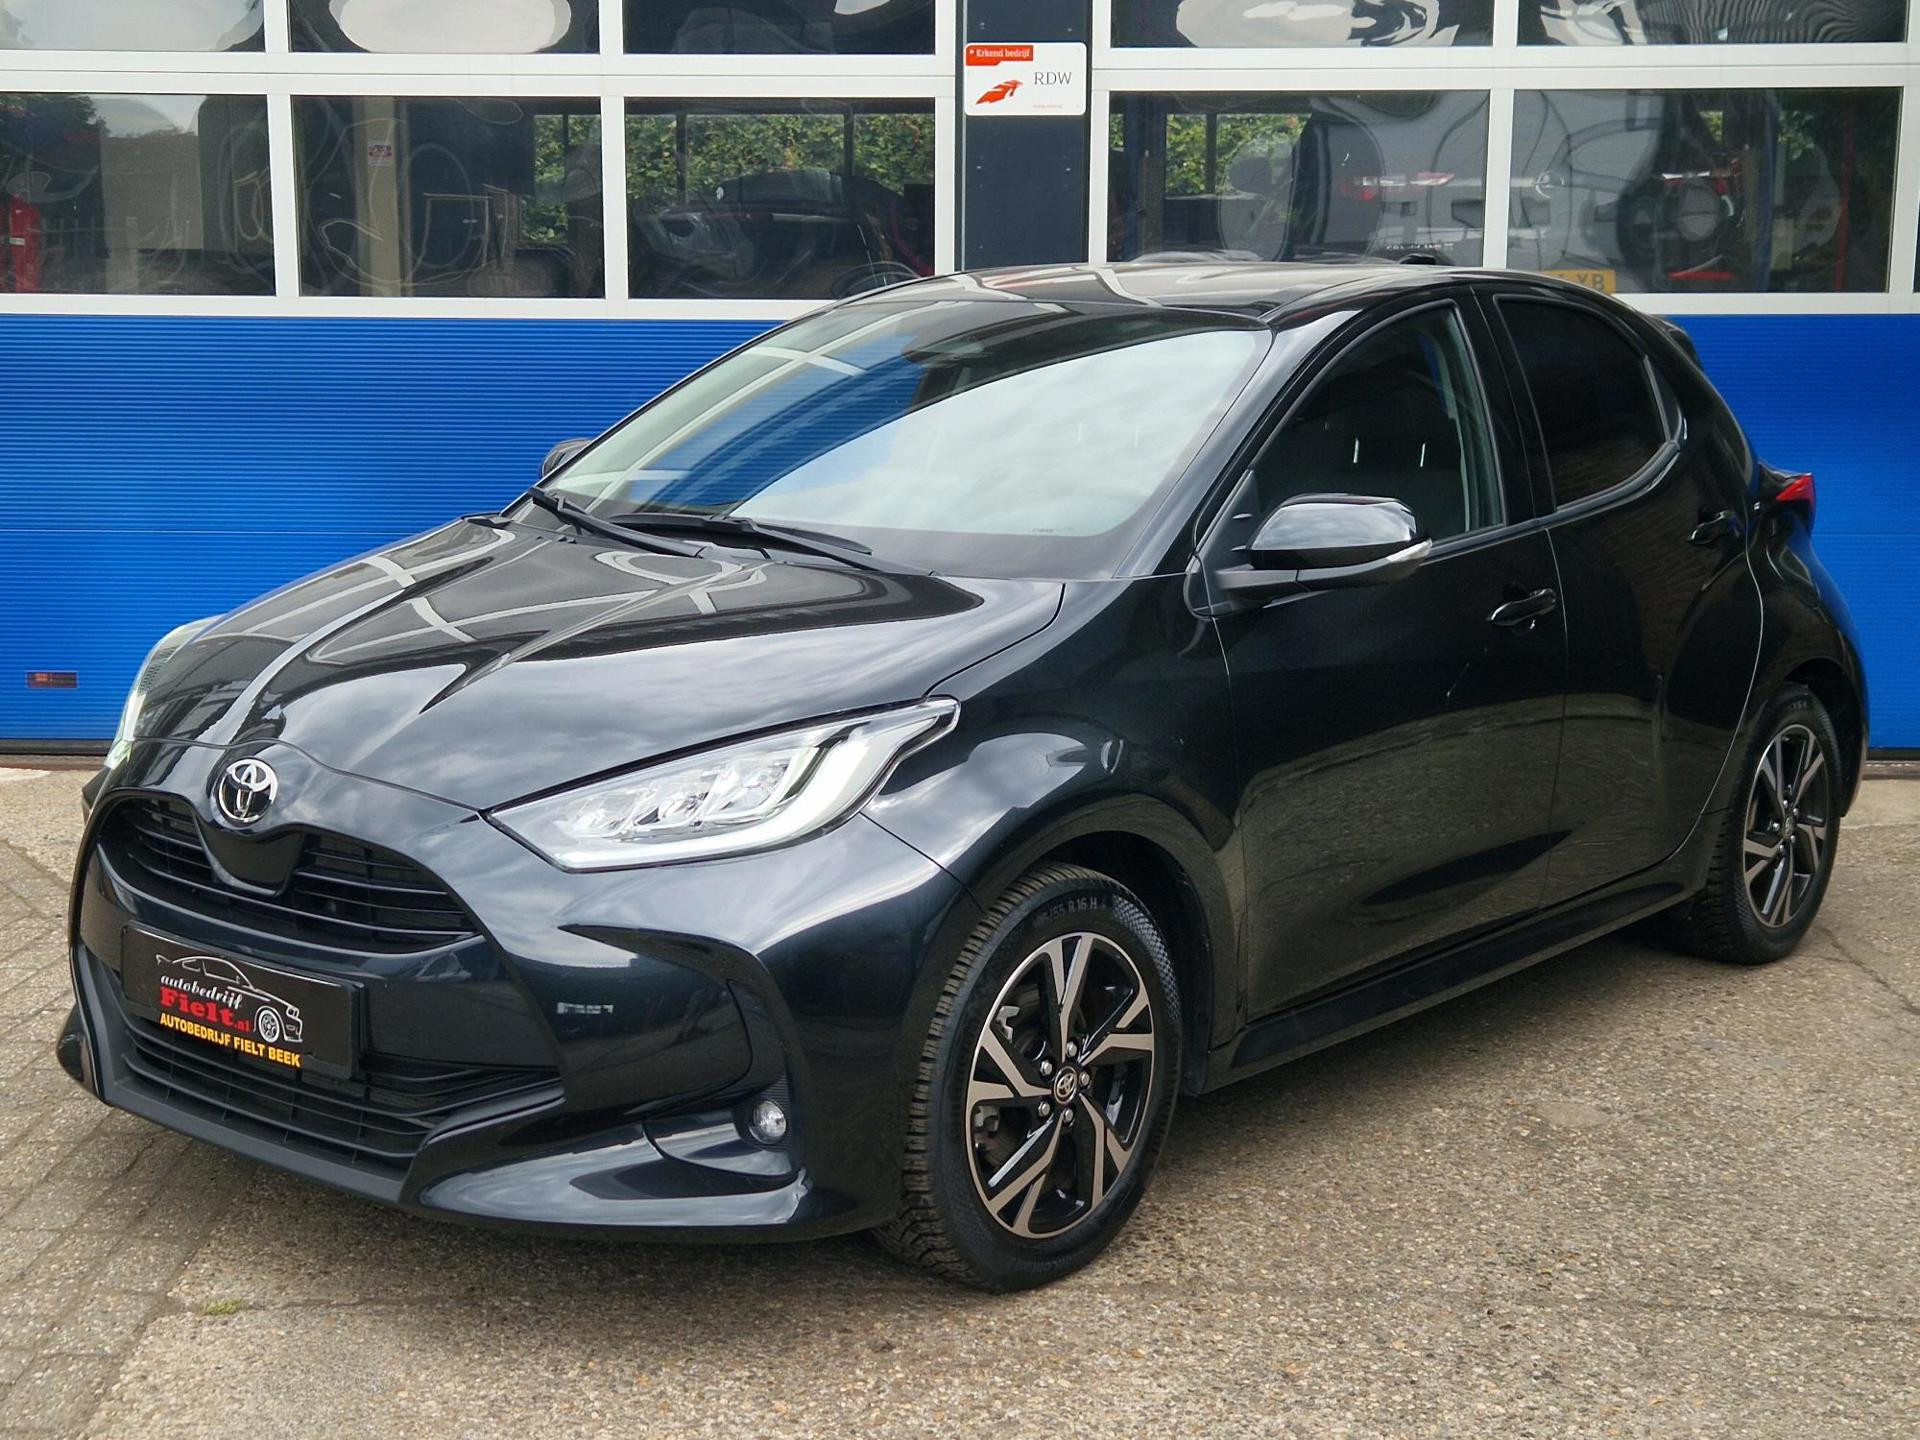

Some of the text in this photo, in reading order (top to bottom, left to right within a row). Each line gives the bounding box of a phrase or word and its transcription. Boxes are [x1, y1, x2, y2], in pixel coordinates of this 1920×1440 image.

[976, 48, 1030, 58] Erkend bedrijf
[1034, 71, 1072, 86] RDW
[161, 976, 243, 1011] autobedrijf
[160, 1013, 301, 1067] AUTOBEDRIJF FIELT BEEK
